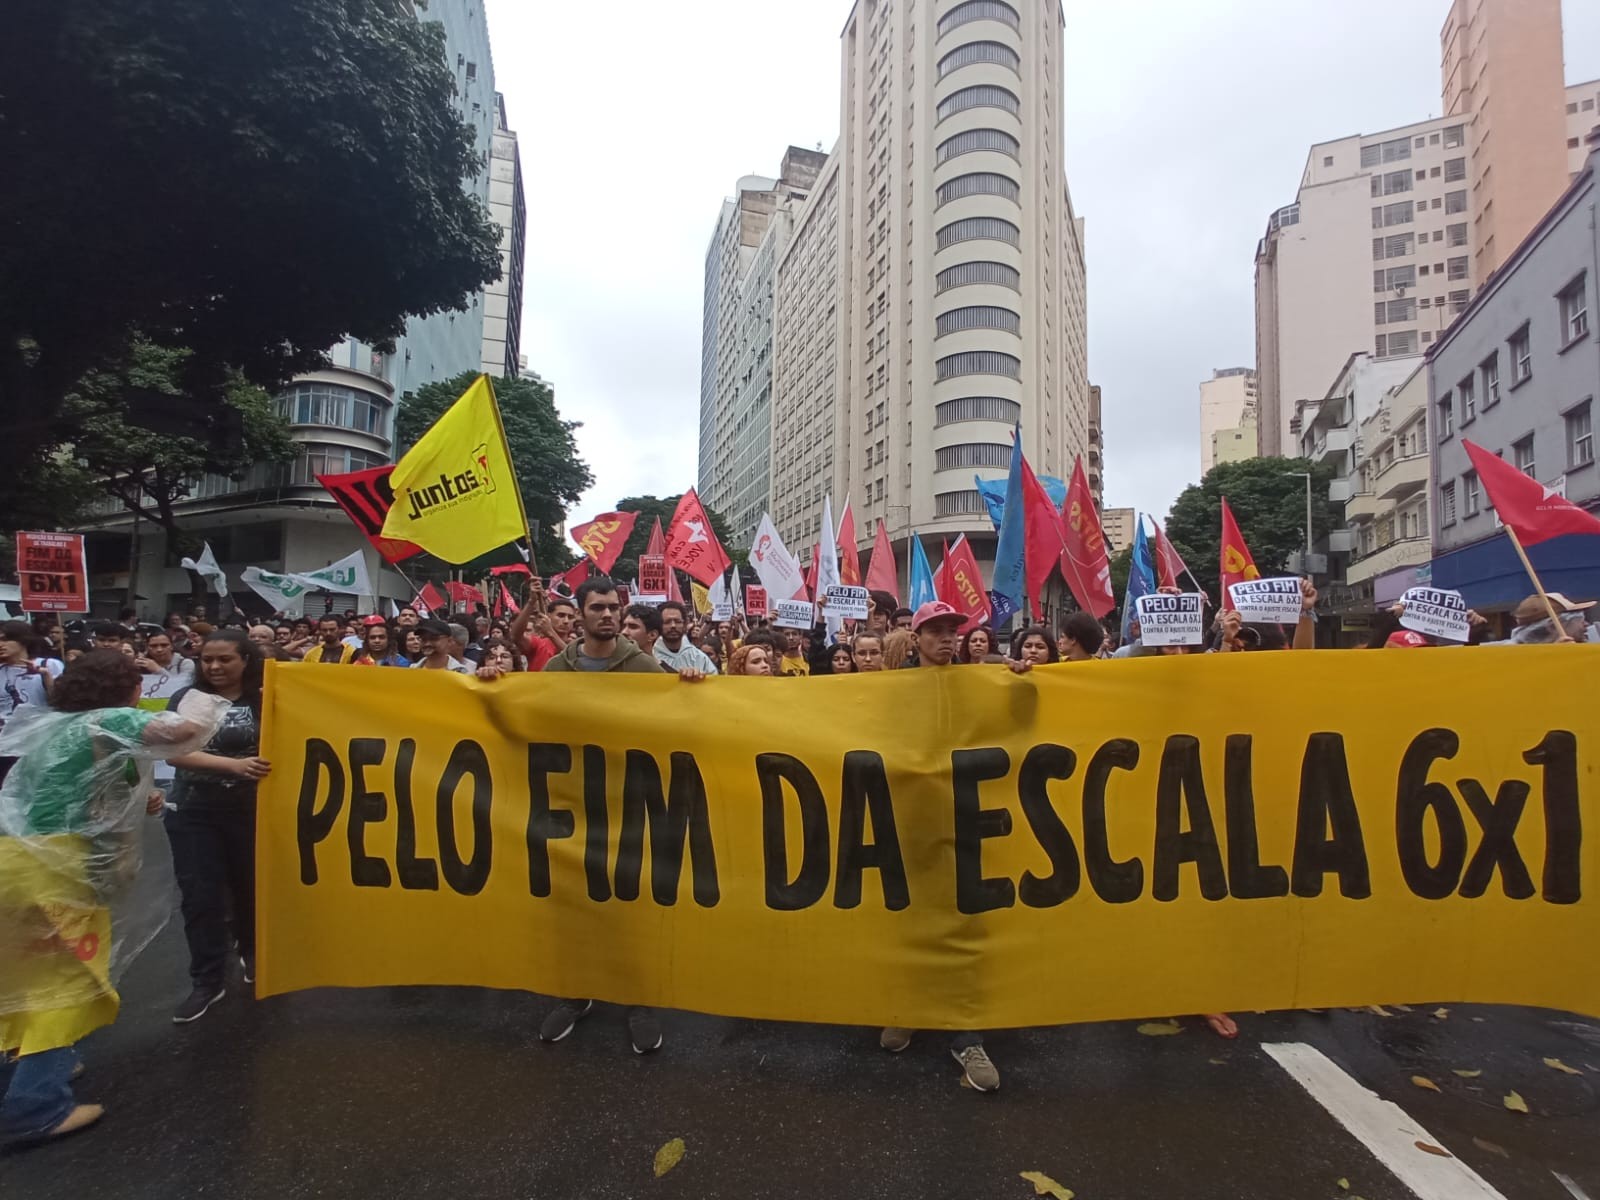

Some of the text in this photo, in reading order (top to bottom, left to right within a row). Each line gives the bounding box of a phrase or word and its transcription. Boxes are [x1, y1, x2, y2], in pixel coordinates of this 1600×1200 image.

[29, 573, 77, 593] 6X1
[643, 579, 666, 590] 6X1
[954, 571, 981, 608] PSTU
[1237, 580, 1295, 594] PELO FIM
[828, 586, 849, 596] PELO
[1408, 590, 1441, 606] PELO
[1144, 597, 1197, 612] PELO FIM
[1250, 595, 1284, 604] ESCALA
[778, 603, 799, 611] ESCALA
[1416, 604, 1450, 619] ESCALA
[1140, 613, 1201, 625] DA ESCALA 6X1
[297, 737, 493, 896] PELO
[526, 741, 720, 908] FIM
[755, 749, 911, 911] DA
[951, 731, 1371, 914] ESCALA
